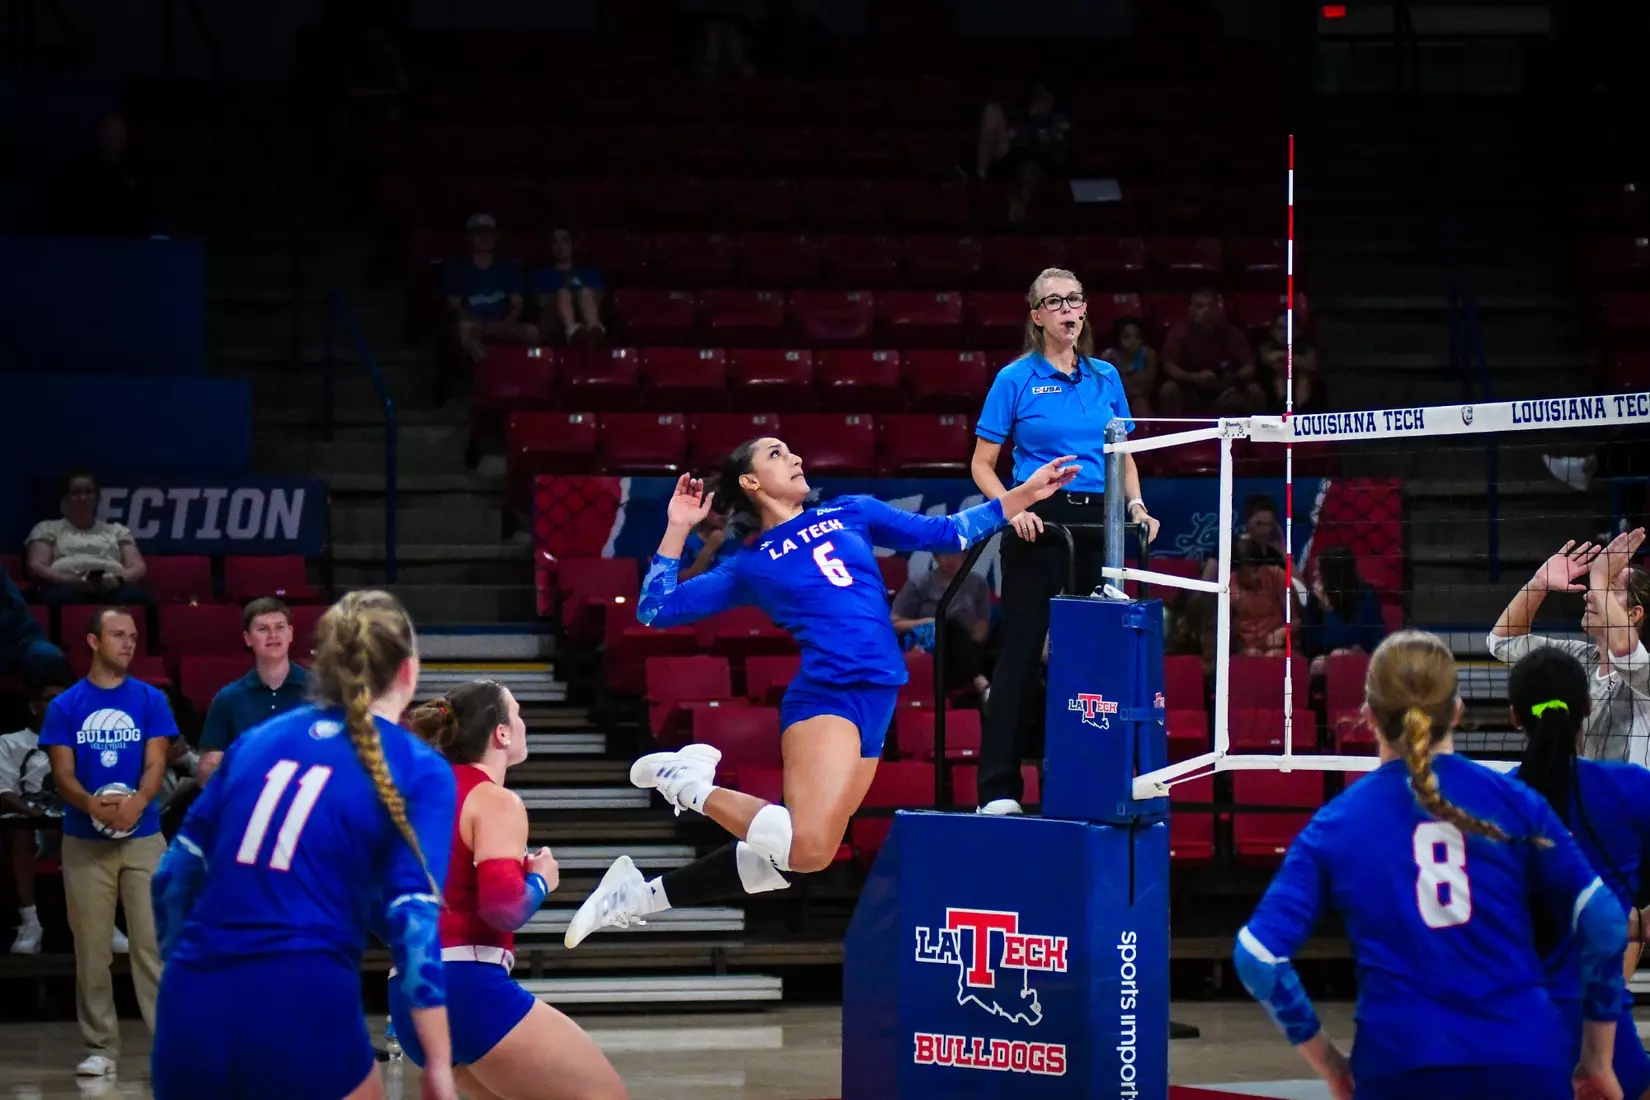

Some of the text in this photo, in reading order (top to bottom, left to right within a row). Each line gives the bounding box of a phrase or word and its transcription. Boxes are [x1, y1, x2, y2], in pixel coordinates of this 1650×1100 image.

[1293, 409, 1424, 436] LOUISIANA TECH
[1512, 394, 1650, 424] LOUISIANA TEC
[95, 487, 306, 540] ECTION
[768, 518, 845, 561] LA TECH
[811, 541, 854, 588] 6
[1068, 693, 1118, 718] LA TECH
[76, 728, 142, 745] BULLDOG
[234, 758, 334, 873] 11
[1412, 820, 1474, 930] 8
[915, 907, 1068, 988] LA TECH
[1115, 930, 1139, 1100] sports import
[914, 1032, 1067, 1076] BULLDOGS
